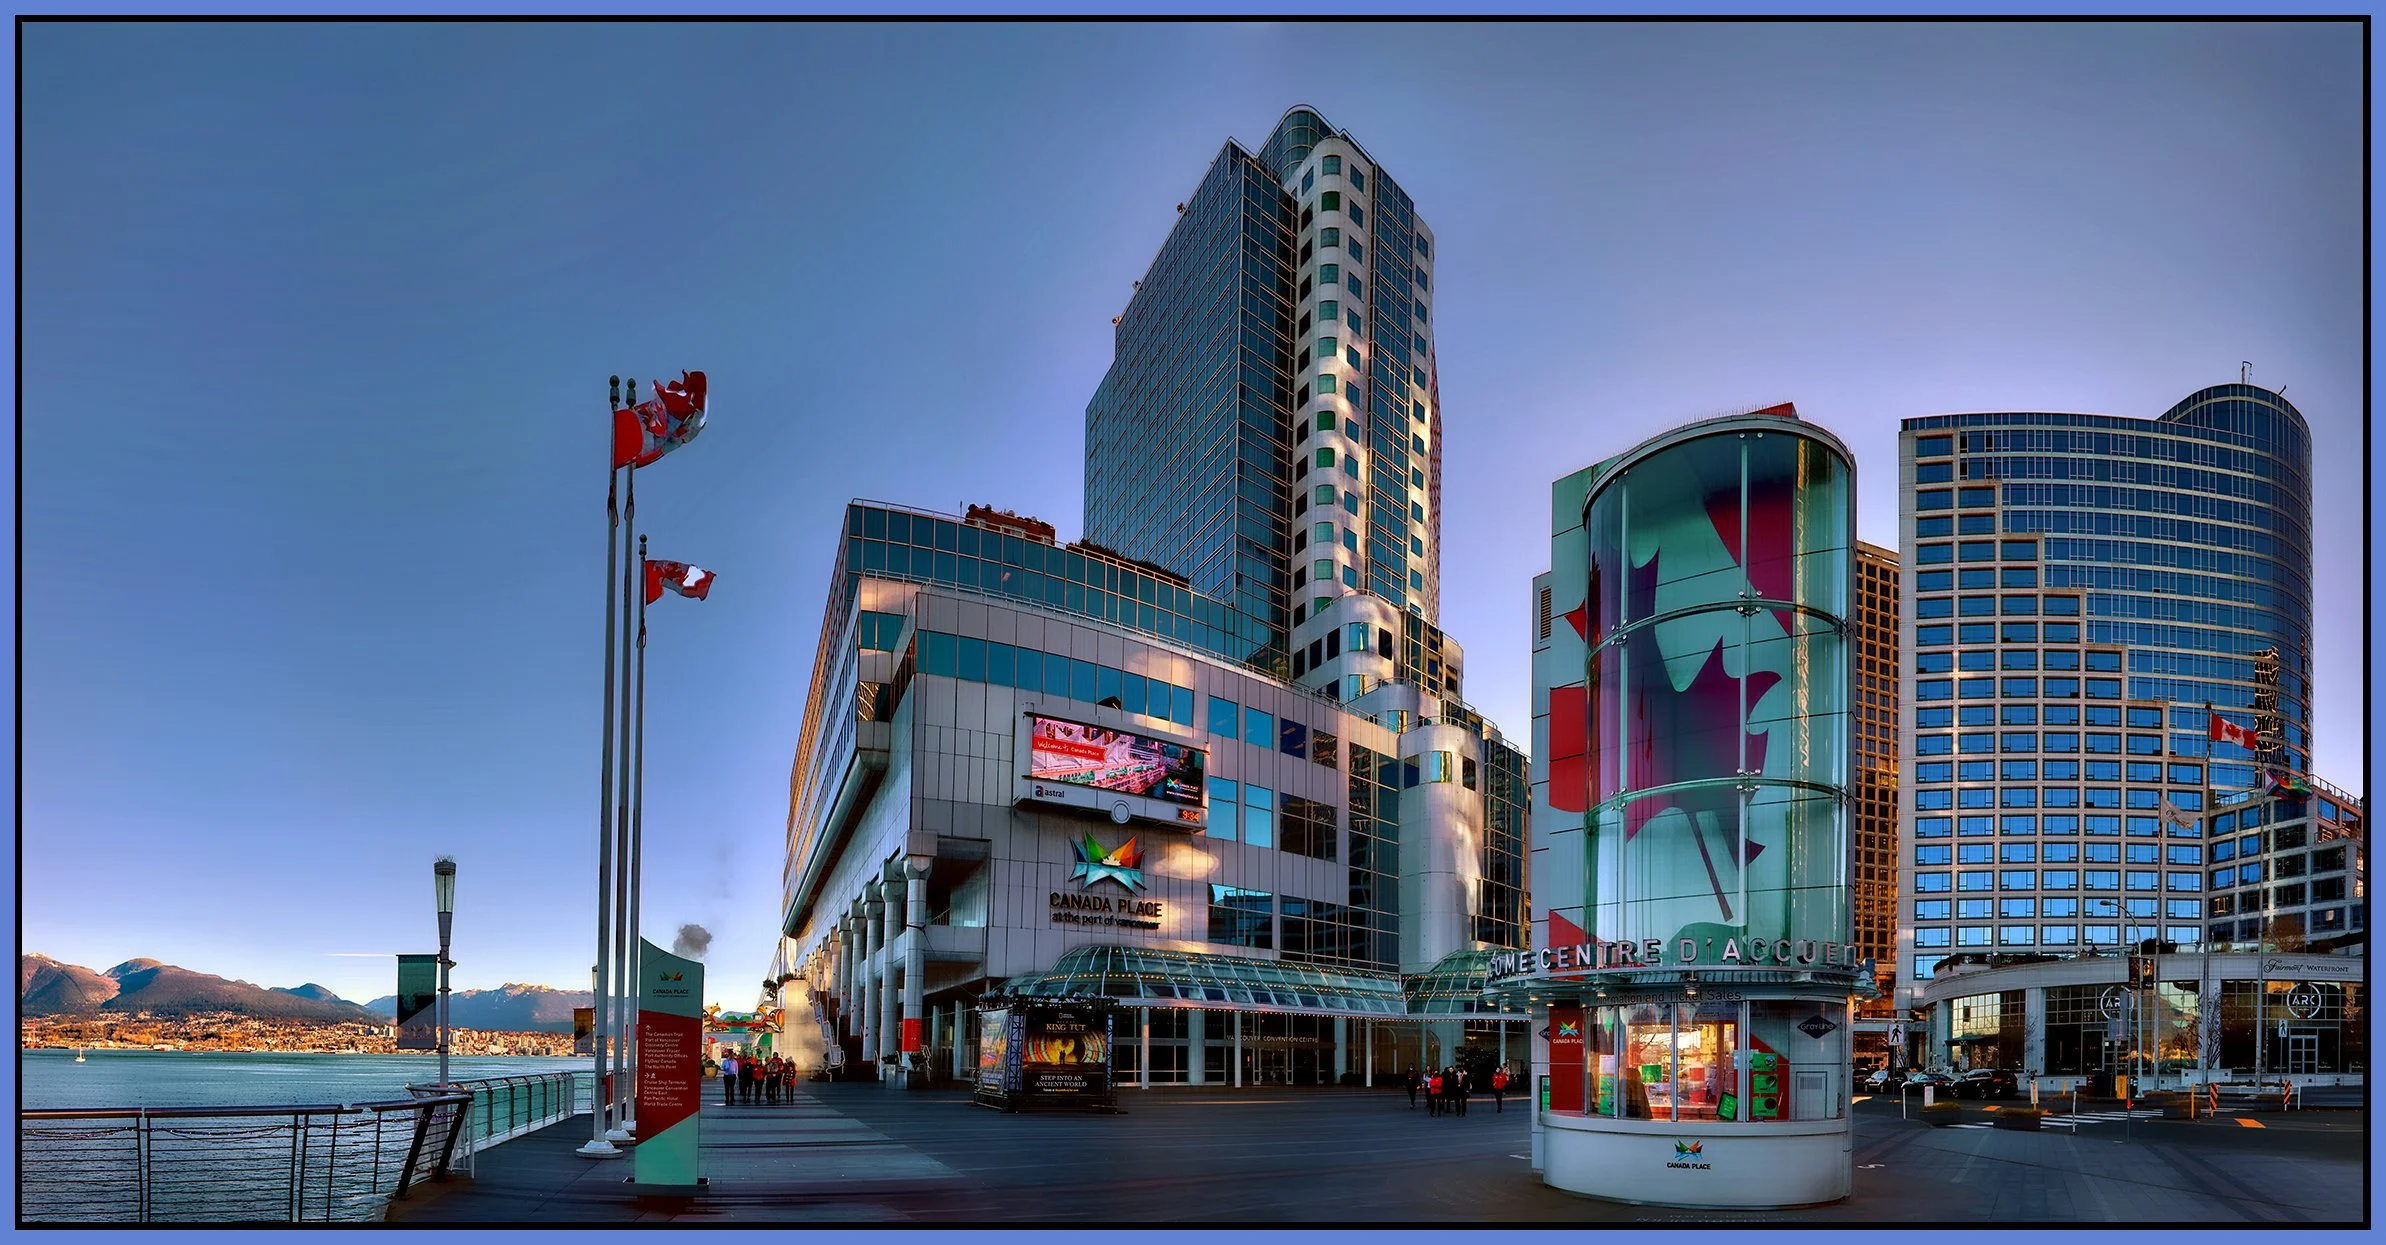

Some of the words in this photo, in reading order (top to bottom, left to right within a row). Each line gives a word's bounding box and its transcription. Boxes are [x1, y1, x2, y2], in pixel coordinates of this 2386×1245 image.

[1070, 746, 1087, 754] Canada
[1044, 789, 1065, 798] astral
[1182, 810, 1199, 822] 9:34
[1049, 892, 1112, 912] CANADA
[1117, 899, 1162, 917] PLACE
[1051, 912, 1063, 922] at
[1063, 911, 1080, 923] the
[1082, 914, 1102, 926] port
[1104, 915, 1114, 926] of
[1540, 939, 1663, 969] CENTRE
[2264, 958, 2304, 973] Fairmont
[2306, 964, 2349, 973] WATERFRONT
[1646, 991, 1665, 1002] and
[1667, 990, 1703, 1002] Ticket
[1707, 989, 1742, 1001] Sales
[2105, 997, 2121, 1008] AR
[1046, 1023, 1066, 1031] KING
[1069, 1023, 1086, 1031] TUT
